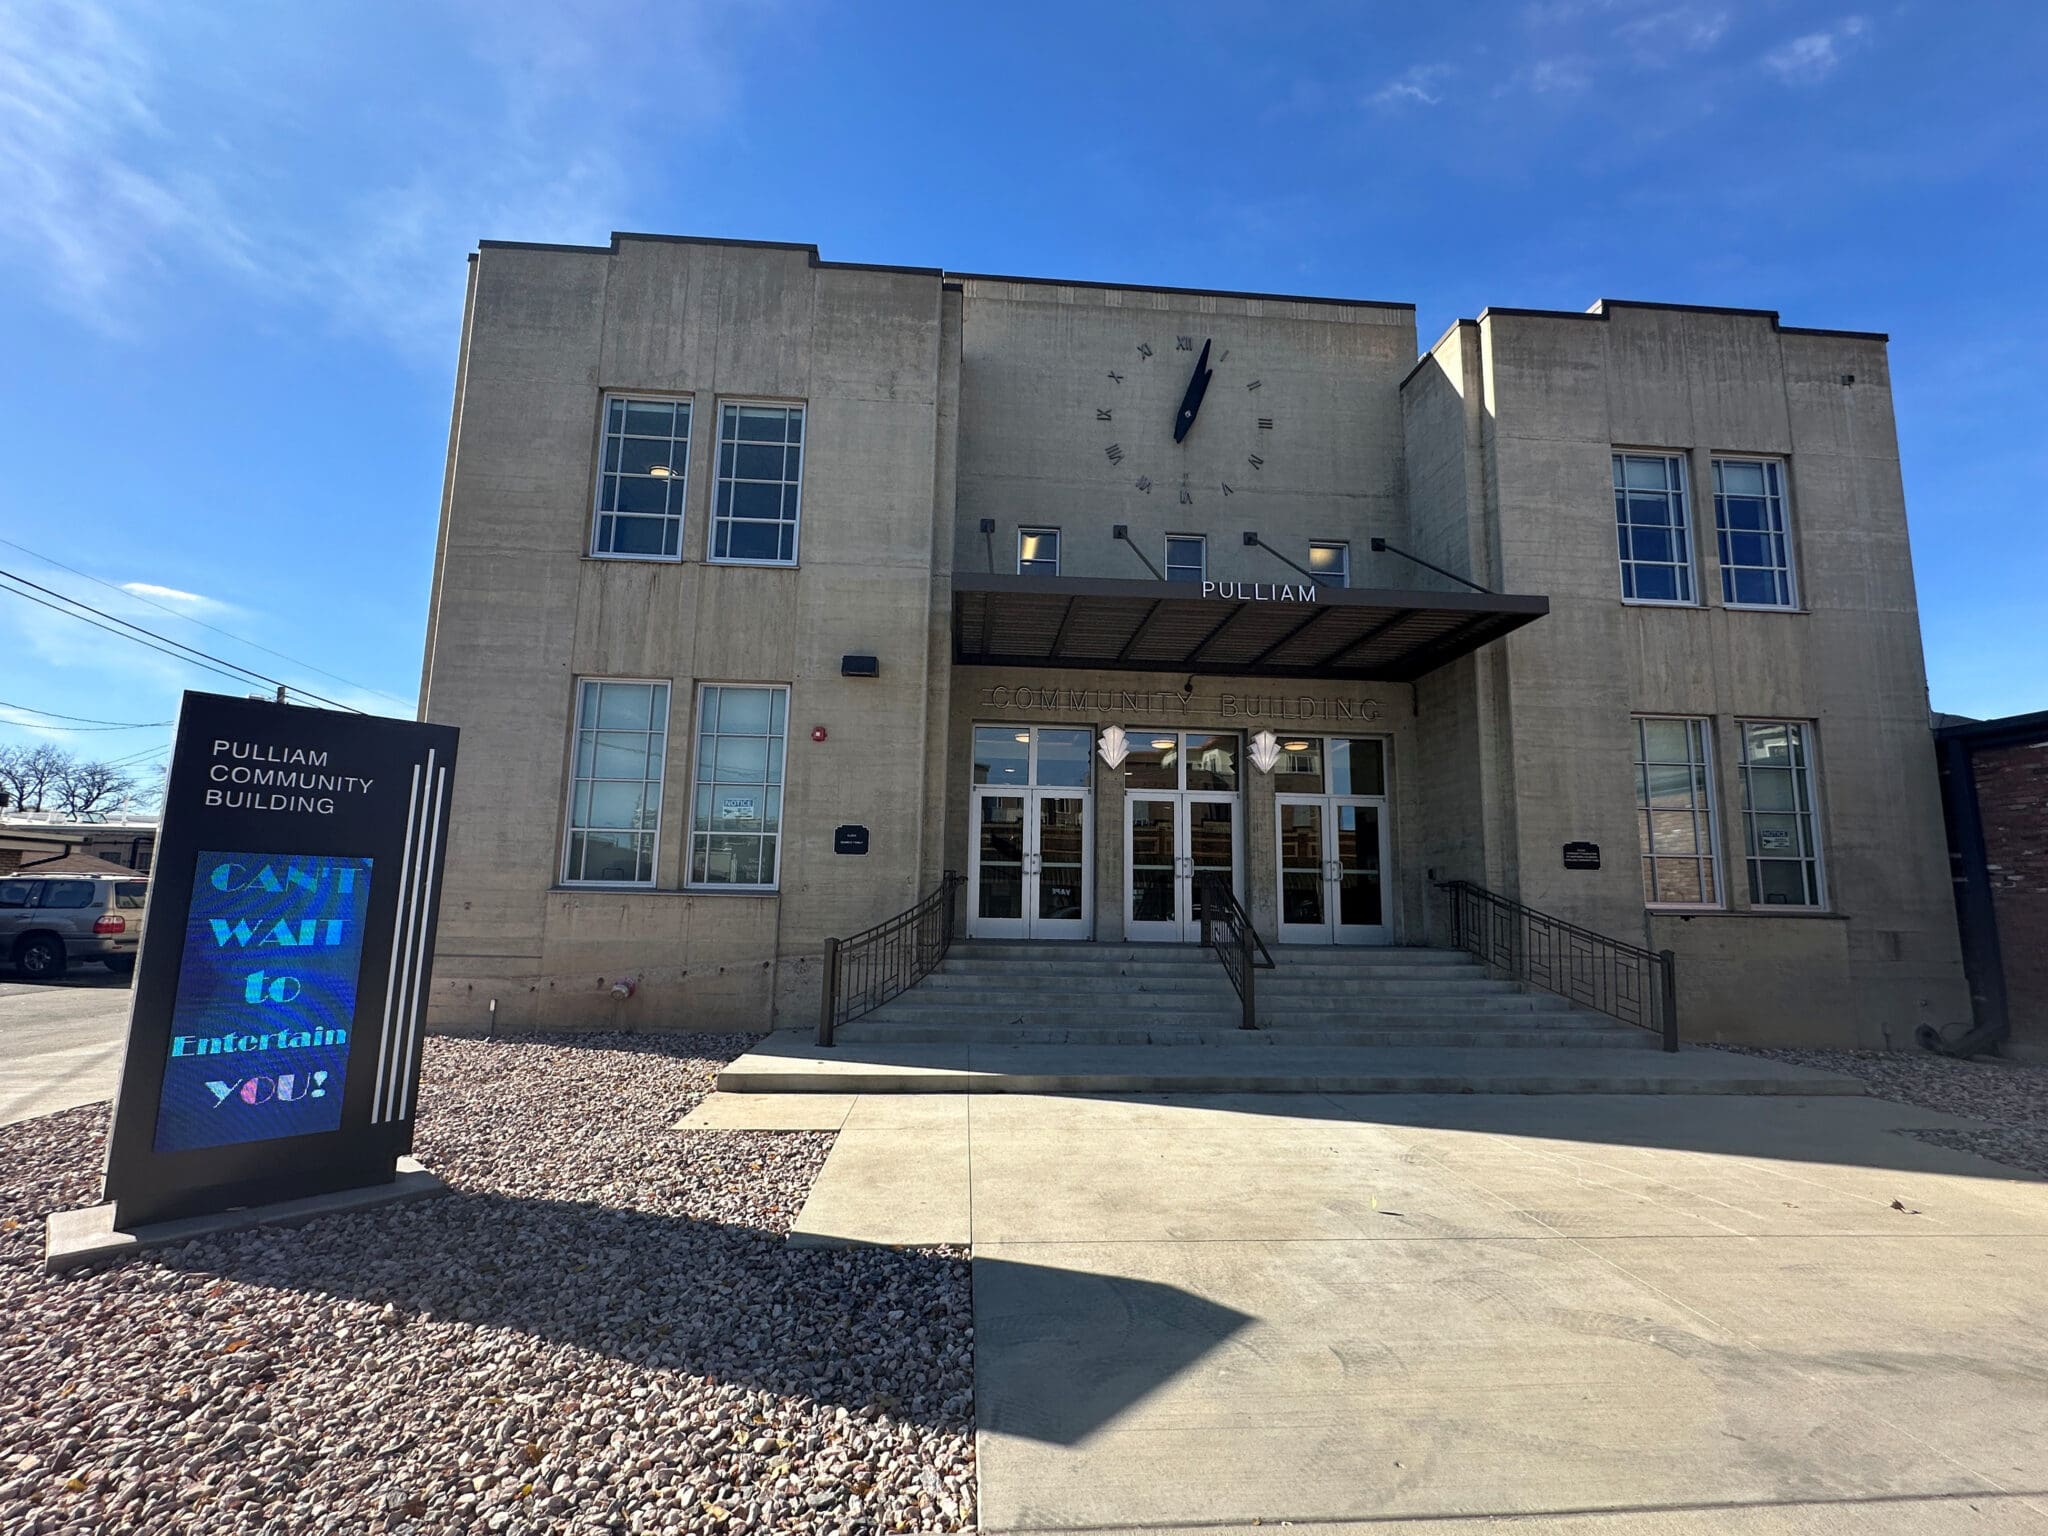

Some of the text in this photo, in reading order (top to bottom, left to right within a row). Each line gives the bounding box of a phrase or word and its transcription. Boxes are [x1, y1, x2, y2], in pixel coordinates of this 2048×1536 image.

[1176, 335, 1193, 351] XII
[1107, 371, 1124, 384] X
[1246, 380, 1262, 391] II
[1096, 408, 1112, 421] IX
[1258, 418, 1273, 429] III
[1202, 581, 1316, 602] PULLIAM
[992, 686, 1378, 721] COMMUNITY BUILDING
[212, 739, 329, 767] PULLIAM
[209, 764, 374, 794] COMMUNITY
[205, 788, 335, 815] BUILDING
[210, 863, 364, 894] CAN'T
[209, 918, 352, 948] WAIT
[244, 969, 302, 1005] to
[172, 1025, 347, 1057] Entertain
